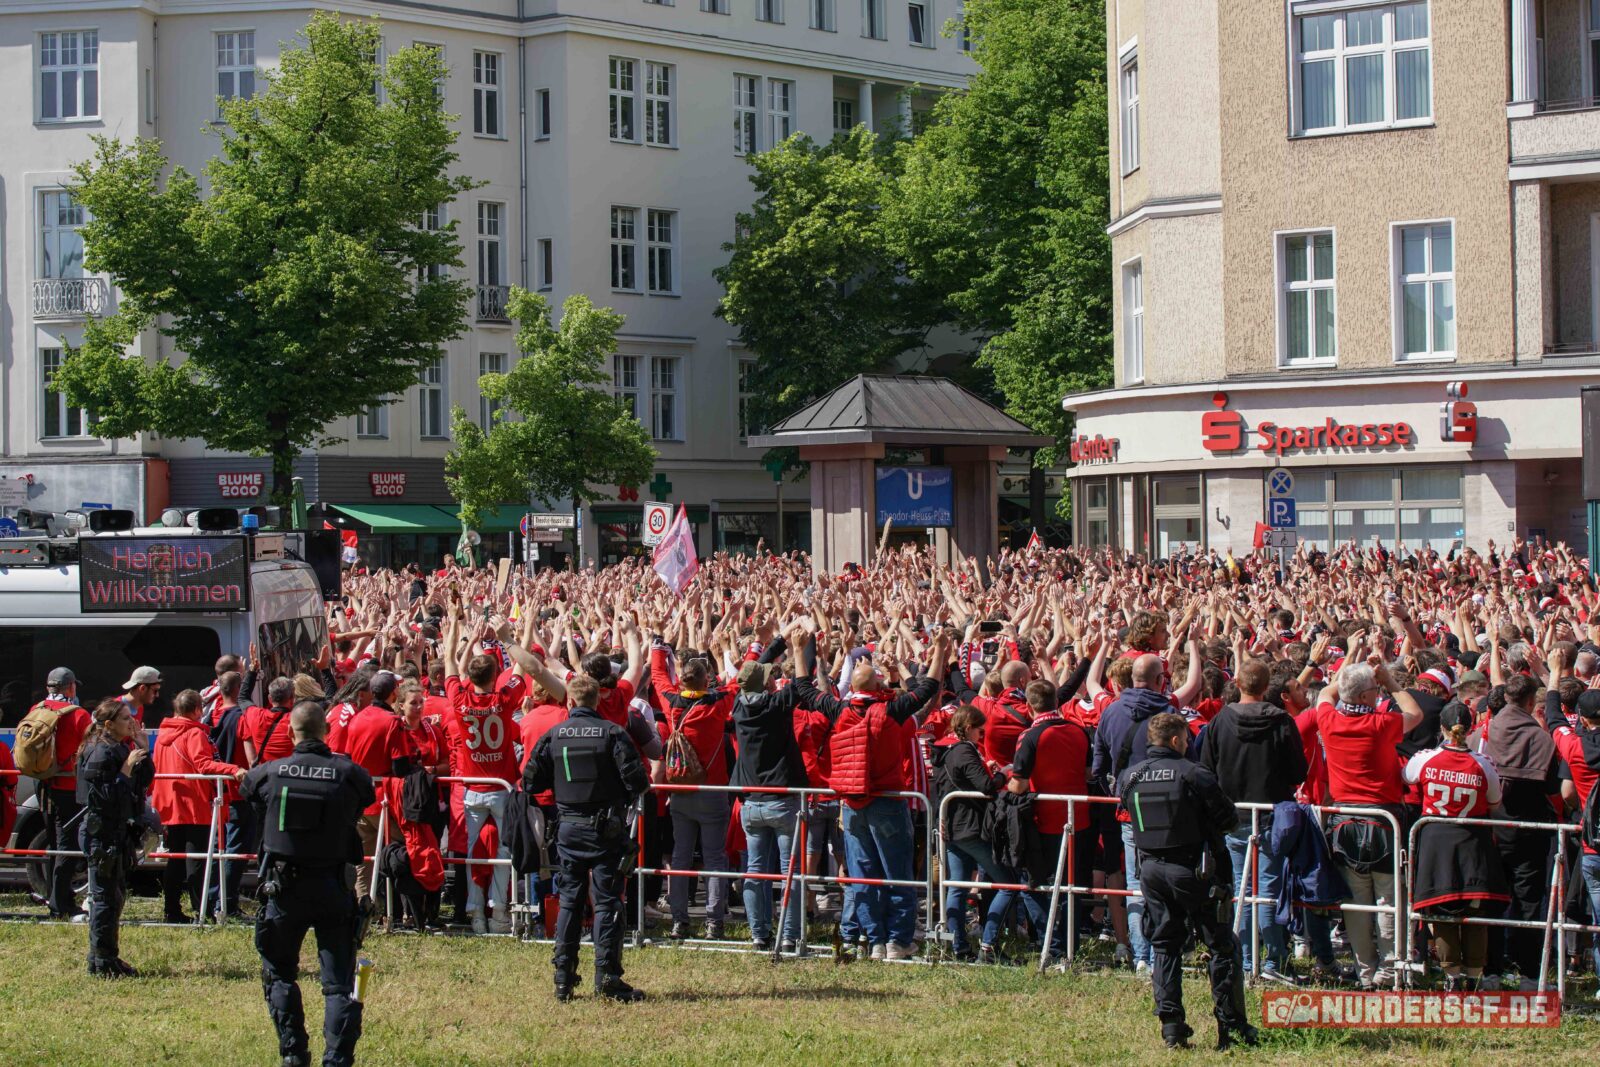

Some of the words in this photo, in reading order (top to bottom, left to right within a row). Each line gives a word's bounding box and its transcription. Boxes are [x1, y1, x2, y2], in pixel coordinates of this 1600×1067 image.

[1257, 417, 1411, 455] Sparkasse
[218, 474, 262, 485] BLUME
[372, 473, 406, 485] BLUME
[907, 472, 923, 500] U
[222, 485, 259, 497] 2000
[375, 485, 404, 496] 2000
[880, 510, 951, 521] Theodor-Heuss-Platz
[1273, 501, 1288, 524] P
[652, 514, 663, 527] 30
[112, 544, 212, 571] Herzlich
[87, 579, 241, 605] Willkommen
[463, 714, 504, 750] 30
[558, 726, 603, 737] POLIZEI
[470, 752, 503, 763] GÜNTER
[278, 764, 336, 780] POLIZEI
[1425, 767, 1438, 780] SC
[1438, 769, 1483, 787] FREIBURG
